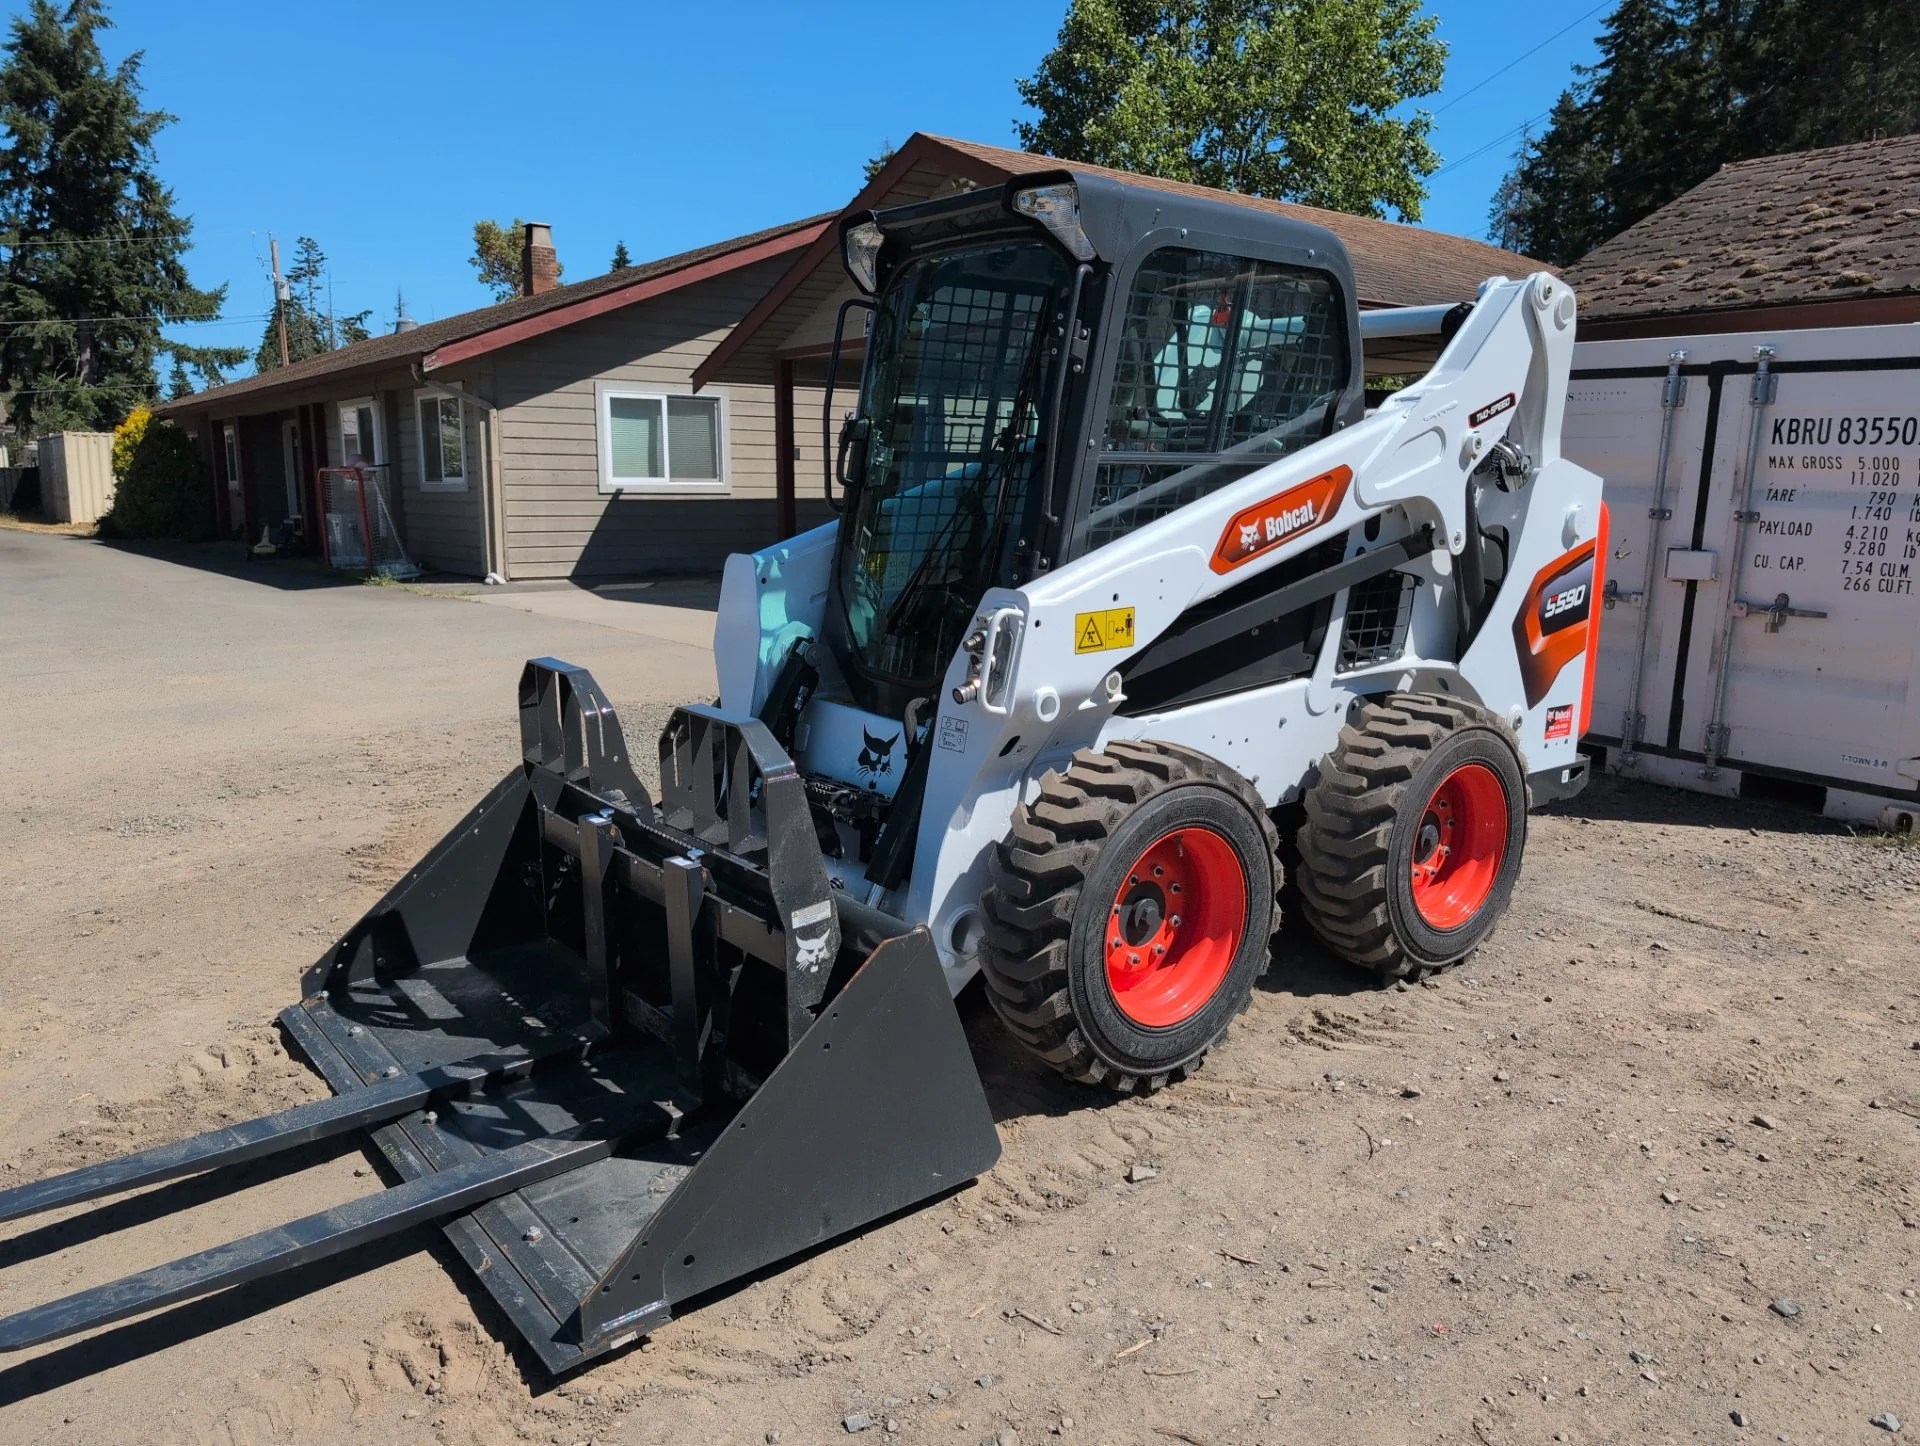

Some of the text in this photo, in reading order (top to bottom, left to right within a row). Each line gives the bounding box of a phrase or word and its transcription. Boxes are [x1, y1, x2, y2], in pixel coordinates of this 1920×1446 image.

[1771, 416, 1920, 446] KBRU 83550
[1768, 455, 1900, 471] MAX GROSS 5.000
[1851, 471, 1900, 487] 11.020
[1766, 488, 1797, 502] TARE
[1868, 491, 1897, 506] 790
[1264, 498, 1315, 541] Bobcat
[1851, 505, 1892, 521] 1.740
[1758, 520, 1813, 537] PAYLOAD
[1846, 525, 1889, 541] 4.210
[1843, 541, 1917, 559] 9.280 lb
[1754, 554, 1773, 569] CU.
[1779, 555, 1807, 571] CAP.
[1841, 560, 1873, 575] 7.54
[1843, 576, 1871, 592] 266
[1544, 584, 1587, 619] S590
[1840, 754, 1871, 766] T-TOWN
